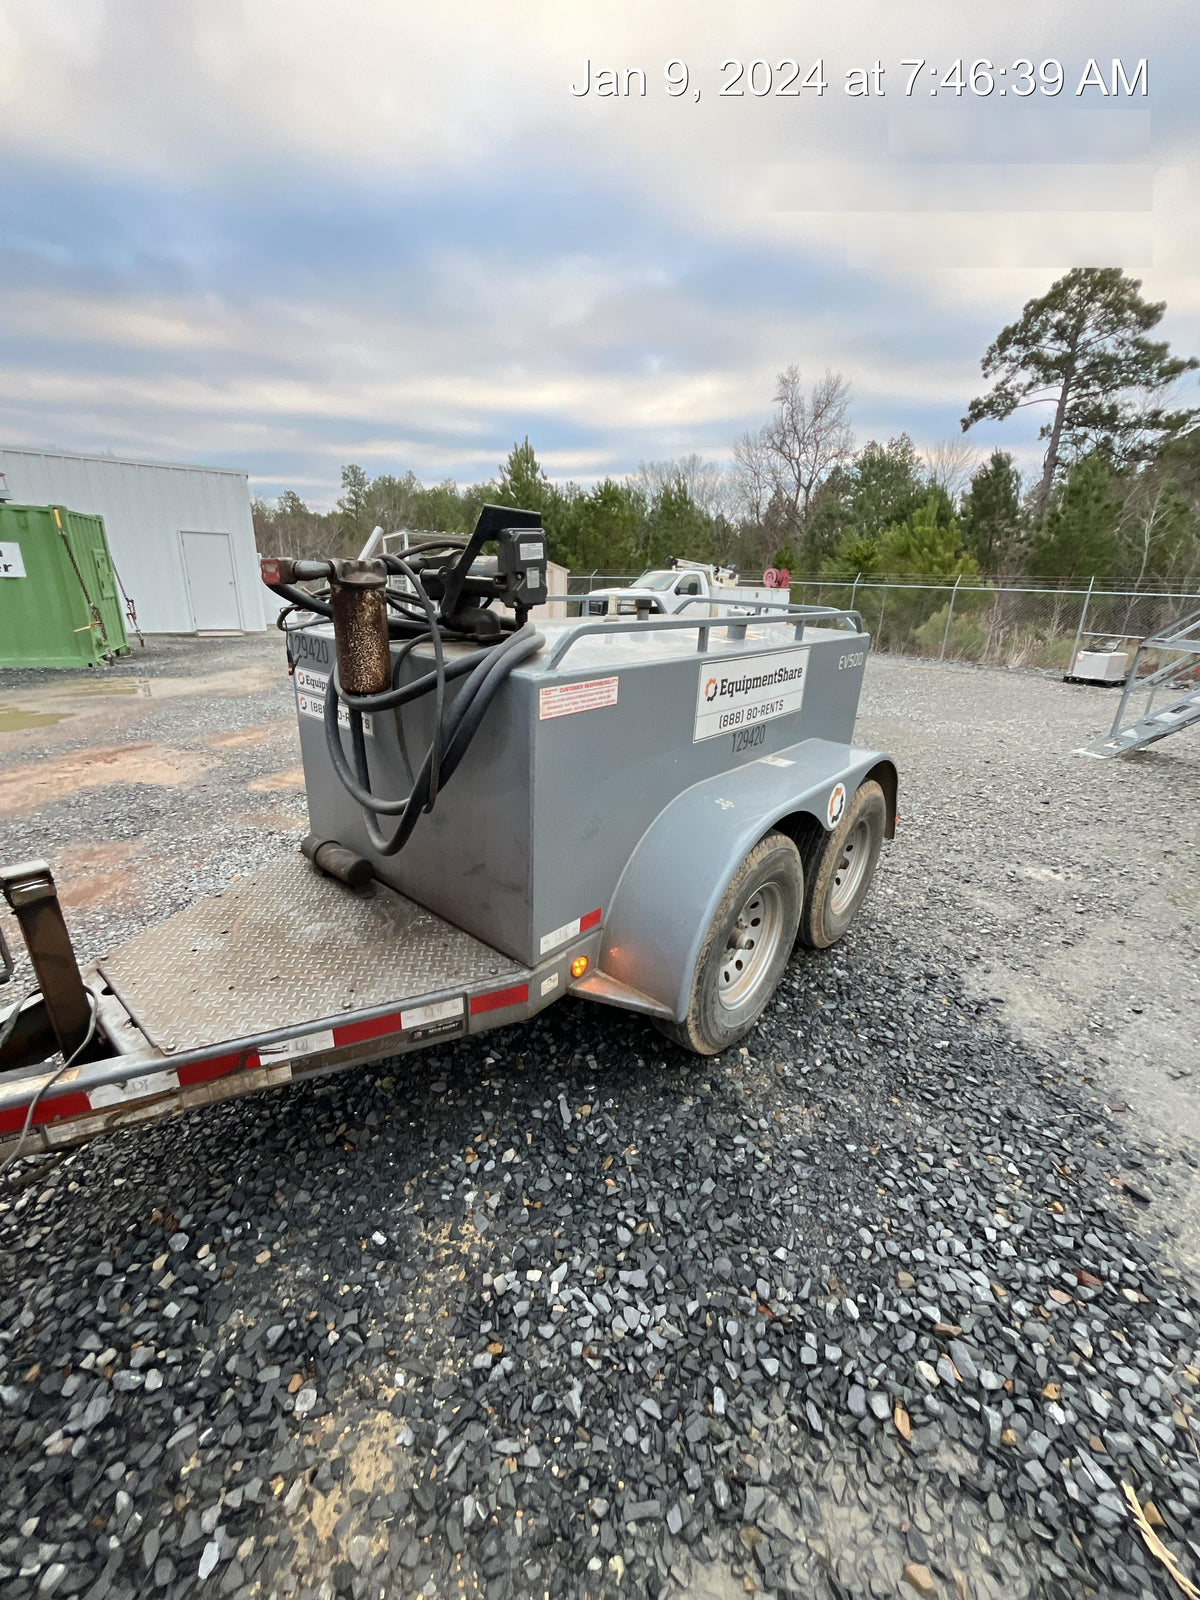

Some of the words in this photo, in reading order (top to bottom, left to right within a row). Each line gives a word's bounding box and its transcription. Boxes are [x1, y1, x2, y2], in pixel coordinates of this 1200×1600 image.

[838, 651, 864, 670] EV500
[306, 674, 328, 692] Equip
[719, 667, 803, 698] EquipmentShare
[719, 709, 745, 730] (888)
[746, 699, 784, 721] 80-RENTS
[731, 724, 766, 754] 129420
